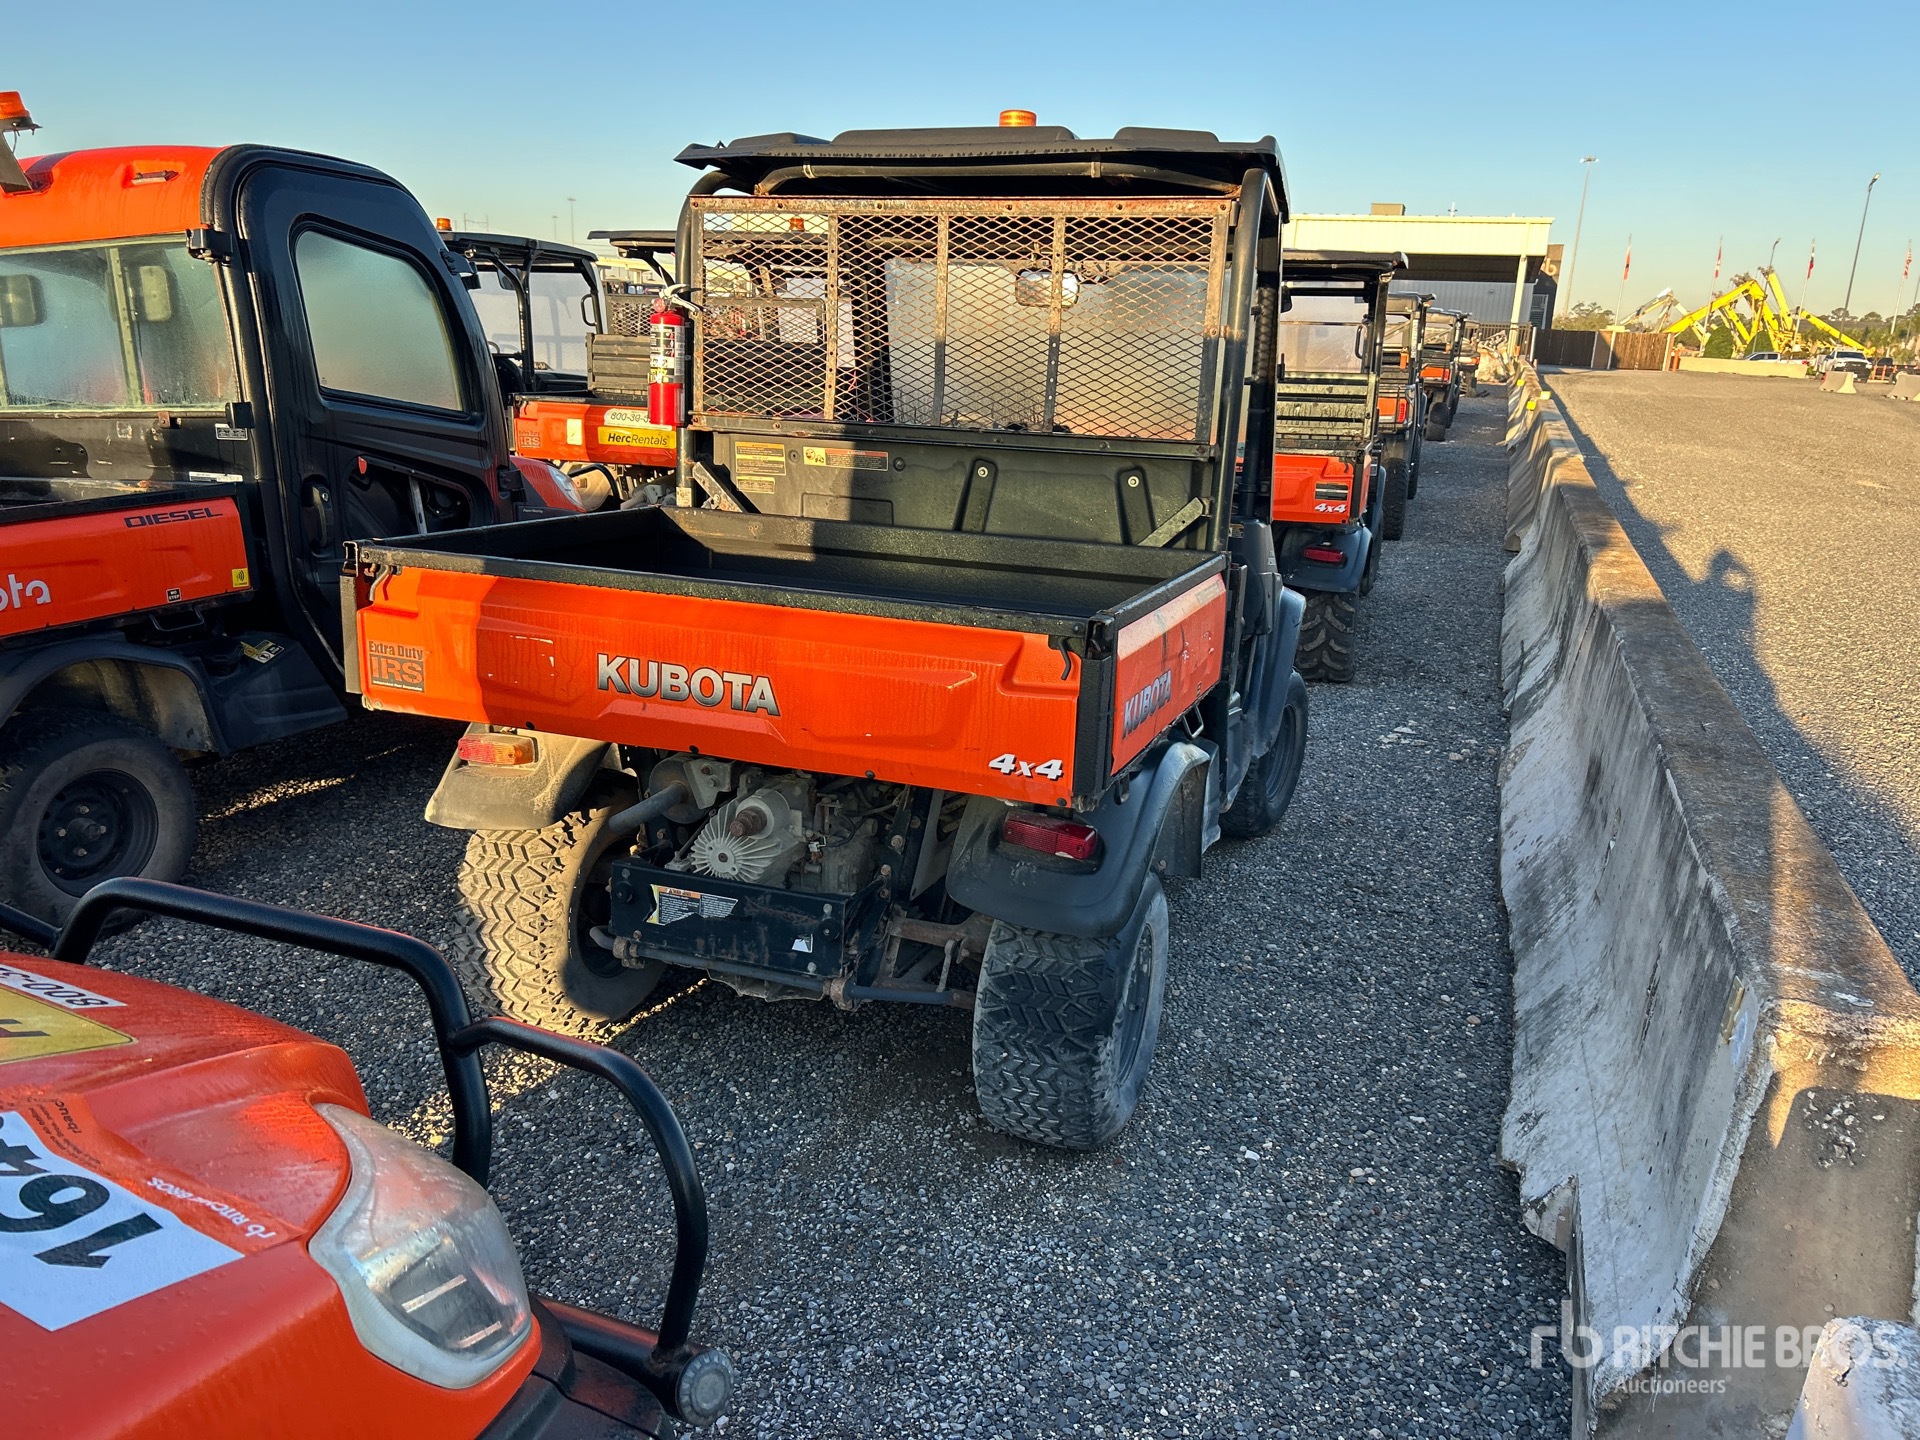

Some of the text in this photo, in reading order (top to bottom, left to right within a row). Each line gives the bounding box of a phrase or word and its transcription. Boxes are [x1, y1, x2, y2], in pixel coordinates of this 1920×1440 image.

[124, 507, 223, 528] DIESEL
[1314, 503, 1347, 513] 4x4
[369, 641, 423, 660] Extra Duty
[371, 656, 423, 684] IRS
[597, 653, 781, 716] KUBOTA
[1122, 669, 1172, 740] KUBOTA
[988, 753, 1064, 781] 4x4
